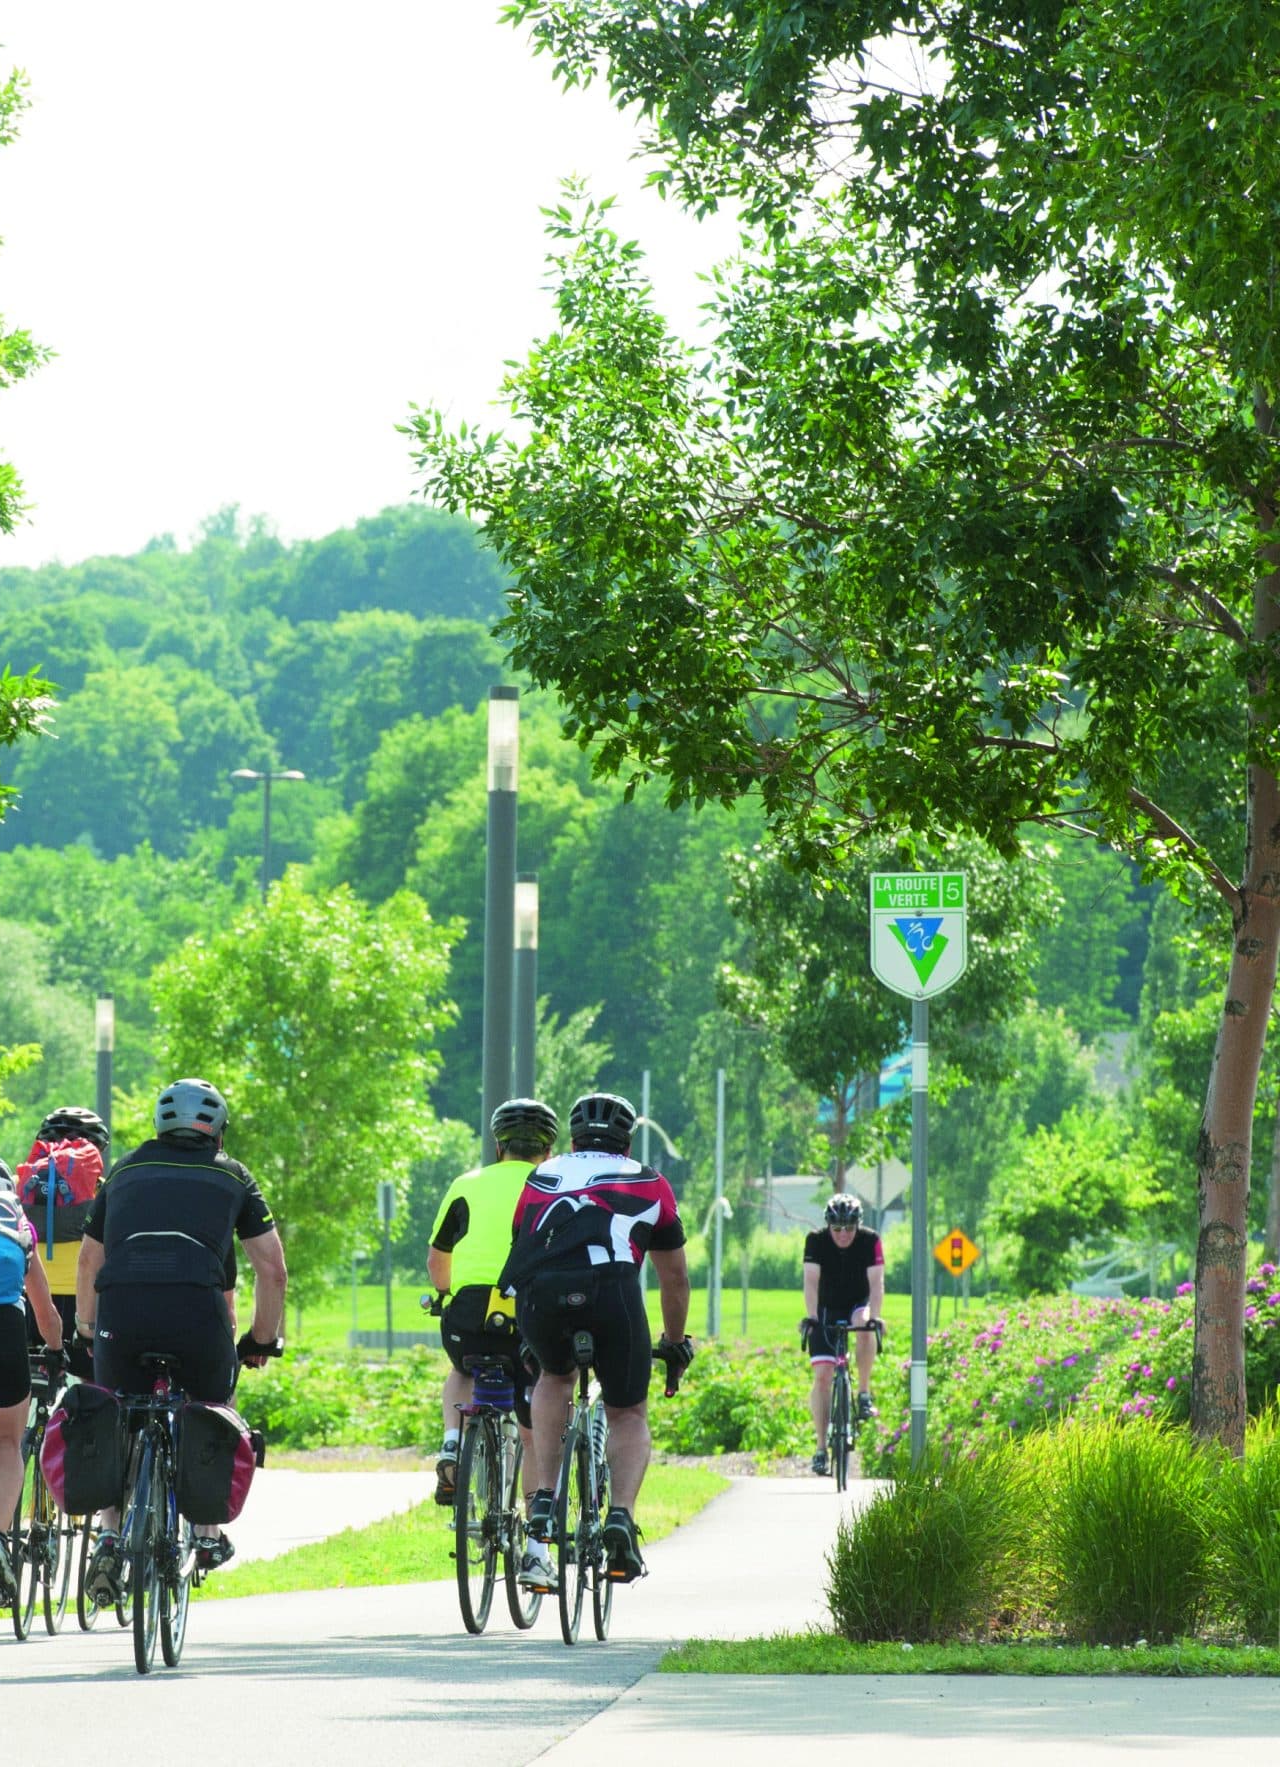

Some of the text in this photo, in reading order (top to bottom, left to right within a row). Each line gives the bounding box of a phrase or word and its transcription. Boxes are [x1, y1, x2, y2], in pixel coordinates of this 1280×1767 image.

[876, 877, 937, 891] LA ROUTE
[946, 882, 960, 900] 5
[889, 893, 928, 906] VERTE
